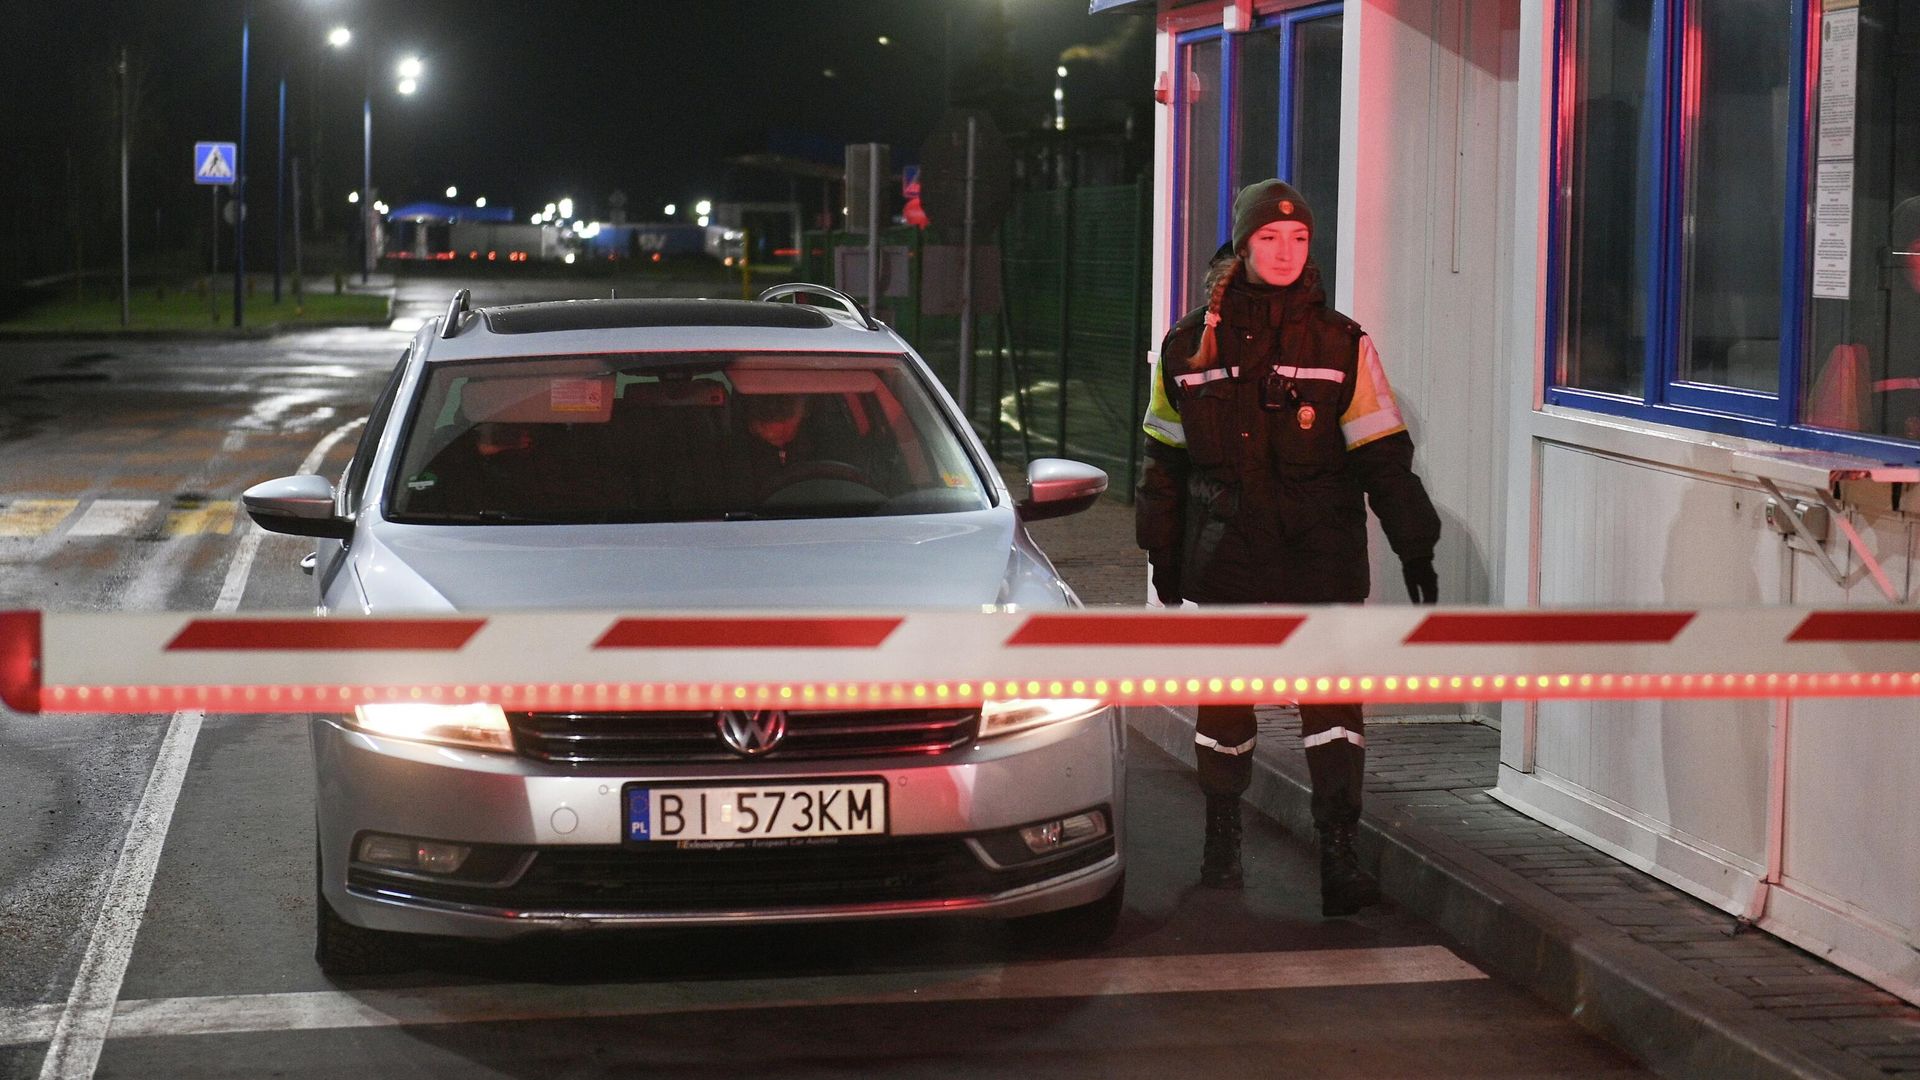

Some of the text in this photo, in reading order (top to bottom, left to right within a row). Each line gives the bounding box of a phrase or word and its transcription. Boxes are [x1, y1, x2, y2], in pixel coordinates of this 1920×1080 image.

[631, 821, 648, 834] PL
[660, 789, 873, 836] BI 573KM
